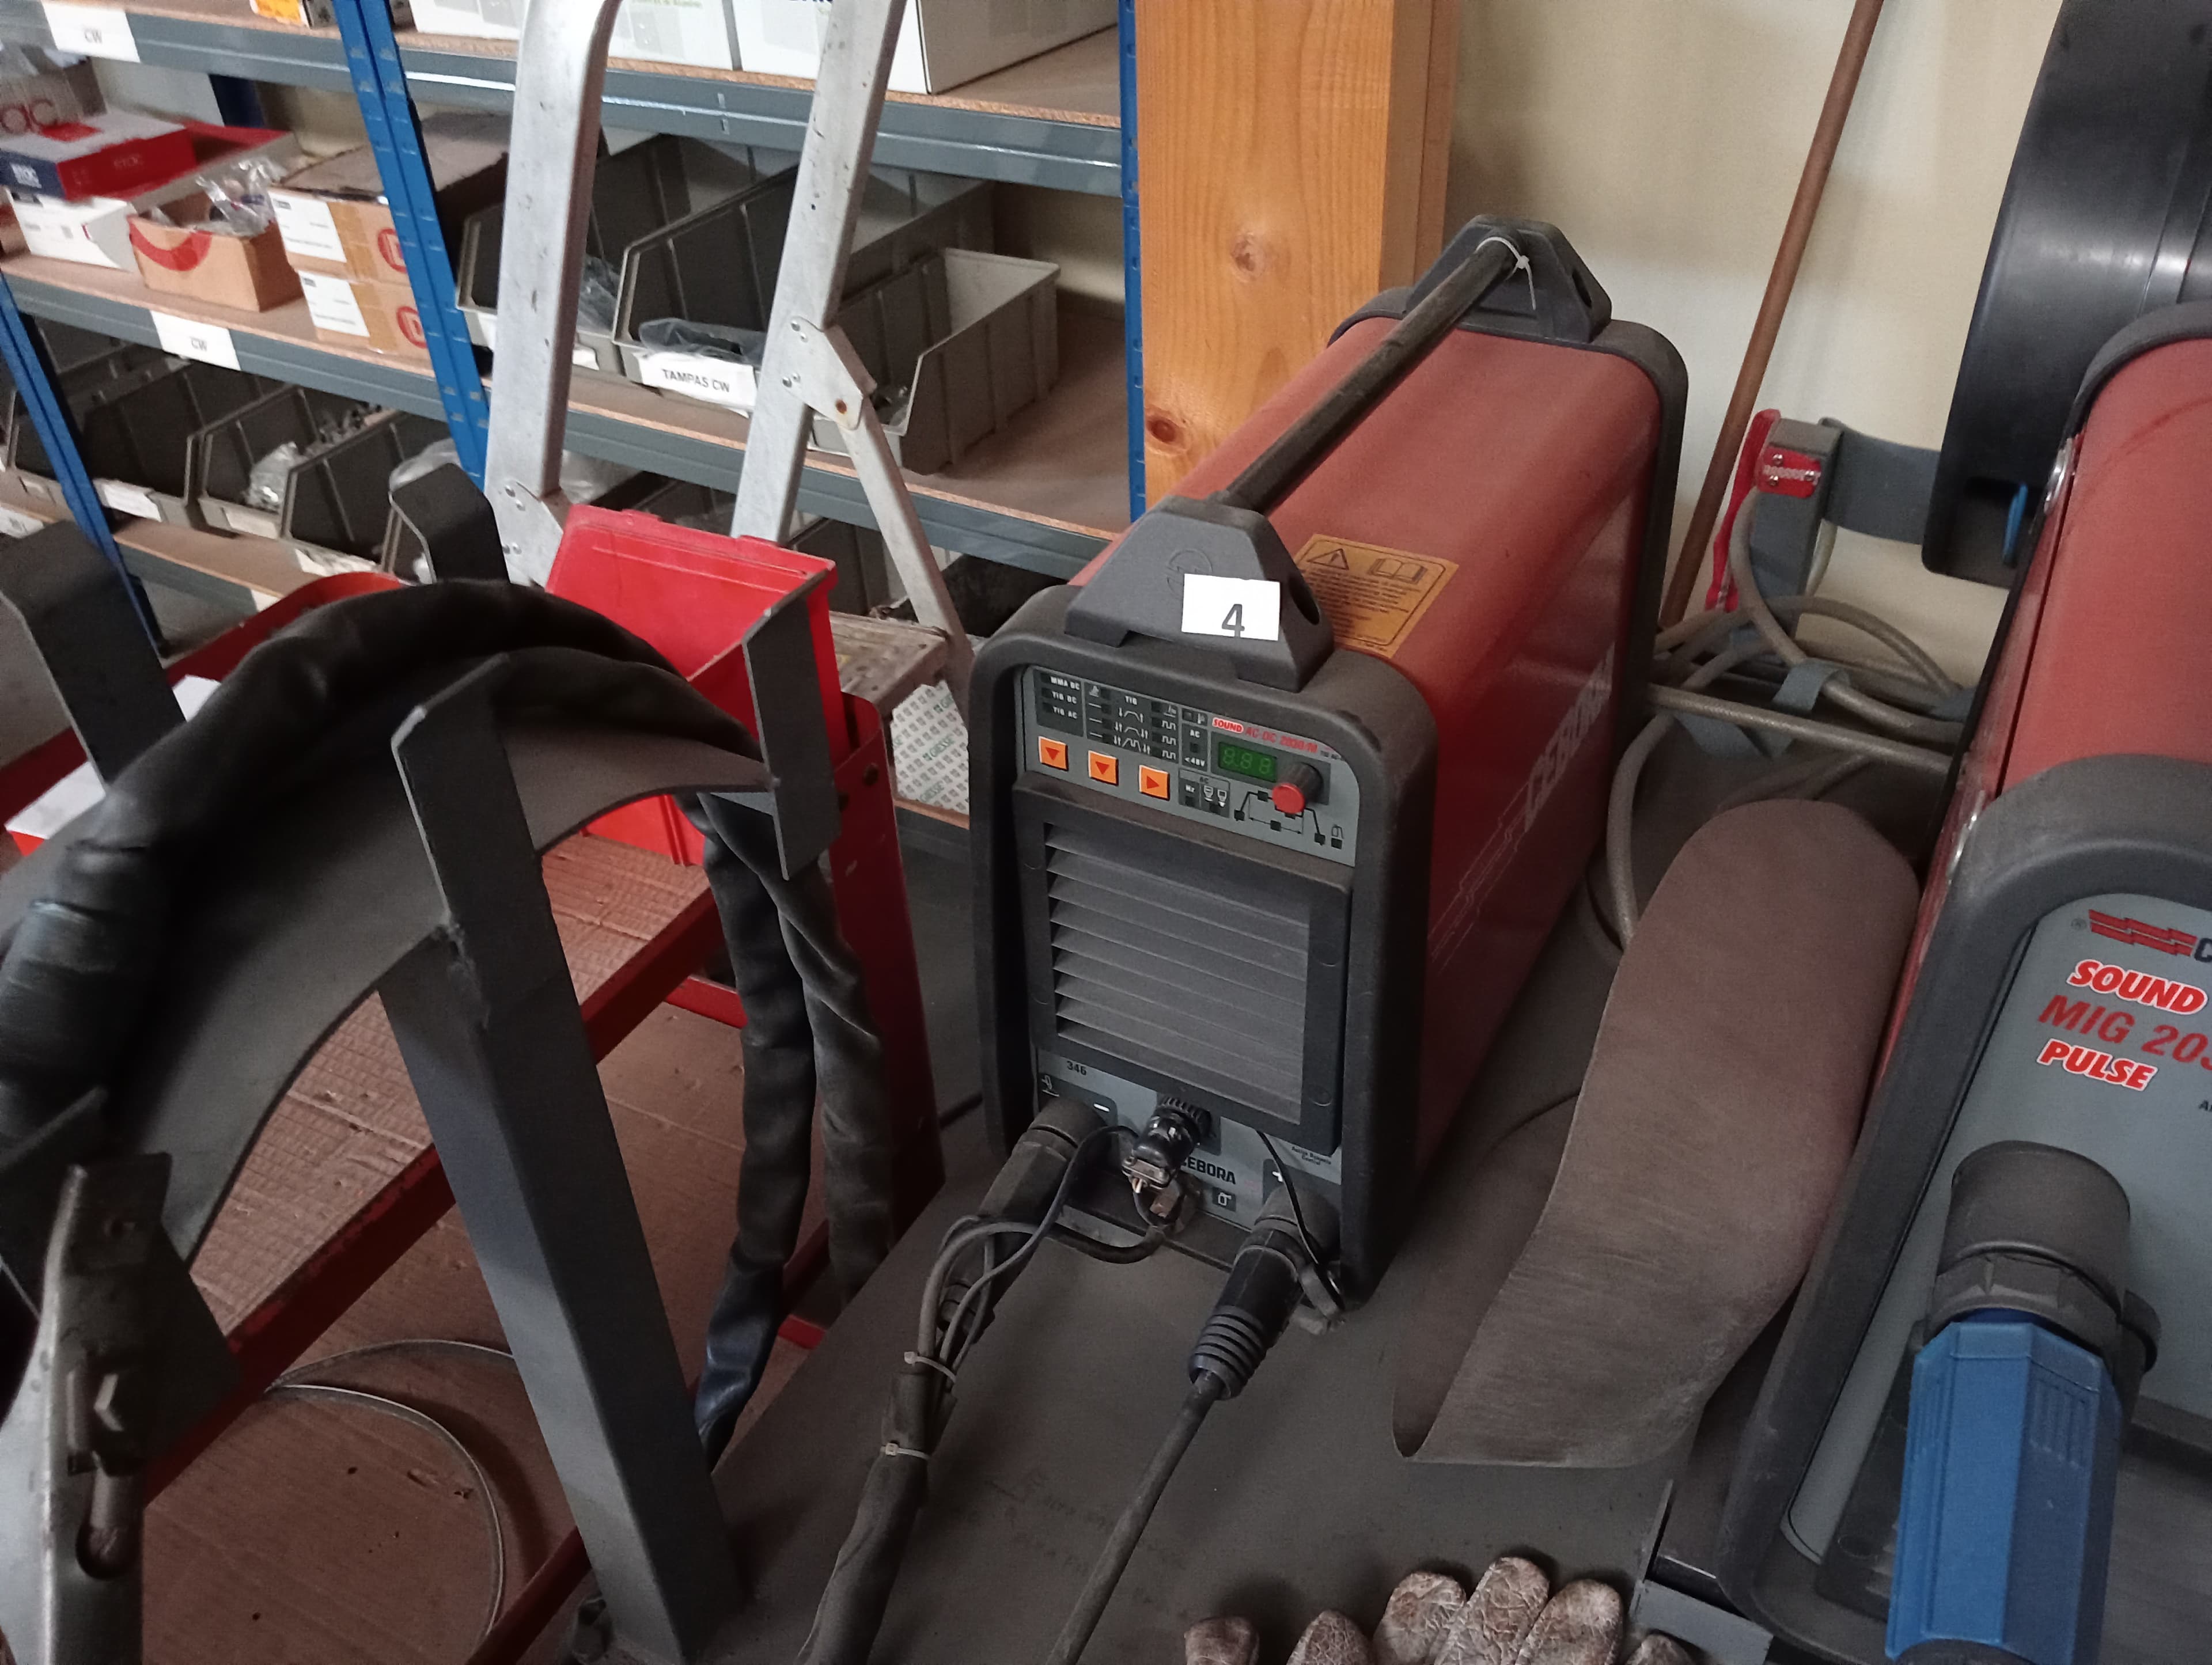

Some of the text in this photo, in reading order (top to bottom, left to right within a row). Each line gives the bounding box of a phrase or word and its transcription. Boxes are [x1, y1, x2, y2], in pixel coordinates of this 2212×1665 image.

[191, 337, 208, 351] CW
[662, 369, 730, 393] TAMPAS CW
[1221, 603, 1245, 638] 4
[1050, 676, 1081, 691] MMA DC
[1052, 691, 1077, 704] TIG DC
[1124, 696, 1138, 705] TIG
[1052, 706, 1078, 719] TIG AC
[1213, 718, 1243, 733] SOUND
[1190, 730, 1200, 738] AC
[2068, 961, 2206, 1014] SOUND
[2037, 995, 2136, 1044] MIG
[1066, 1060, 1087, 1076] 346
[2037, 1039, 2158, 1090] PULSE
